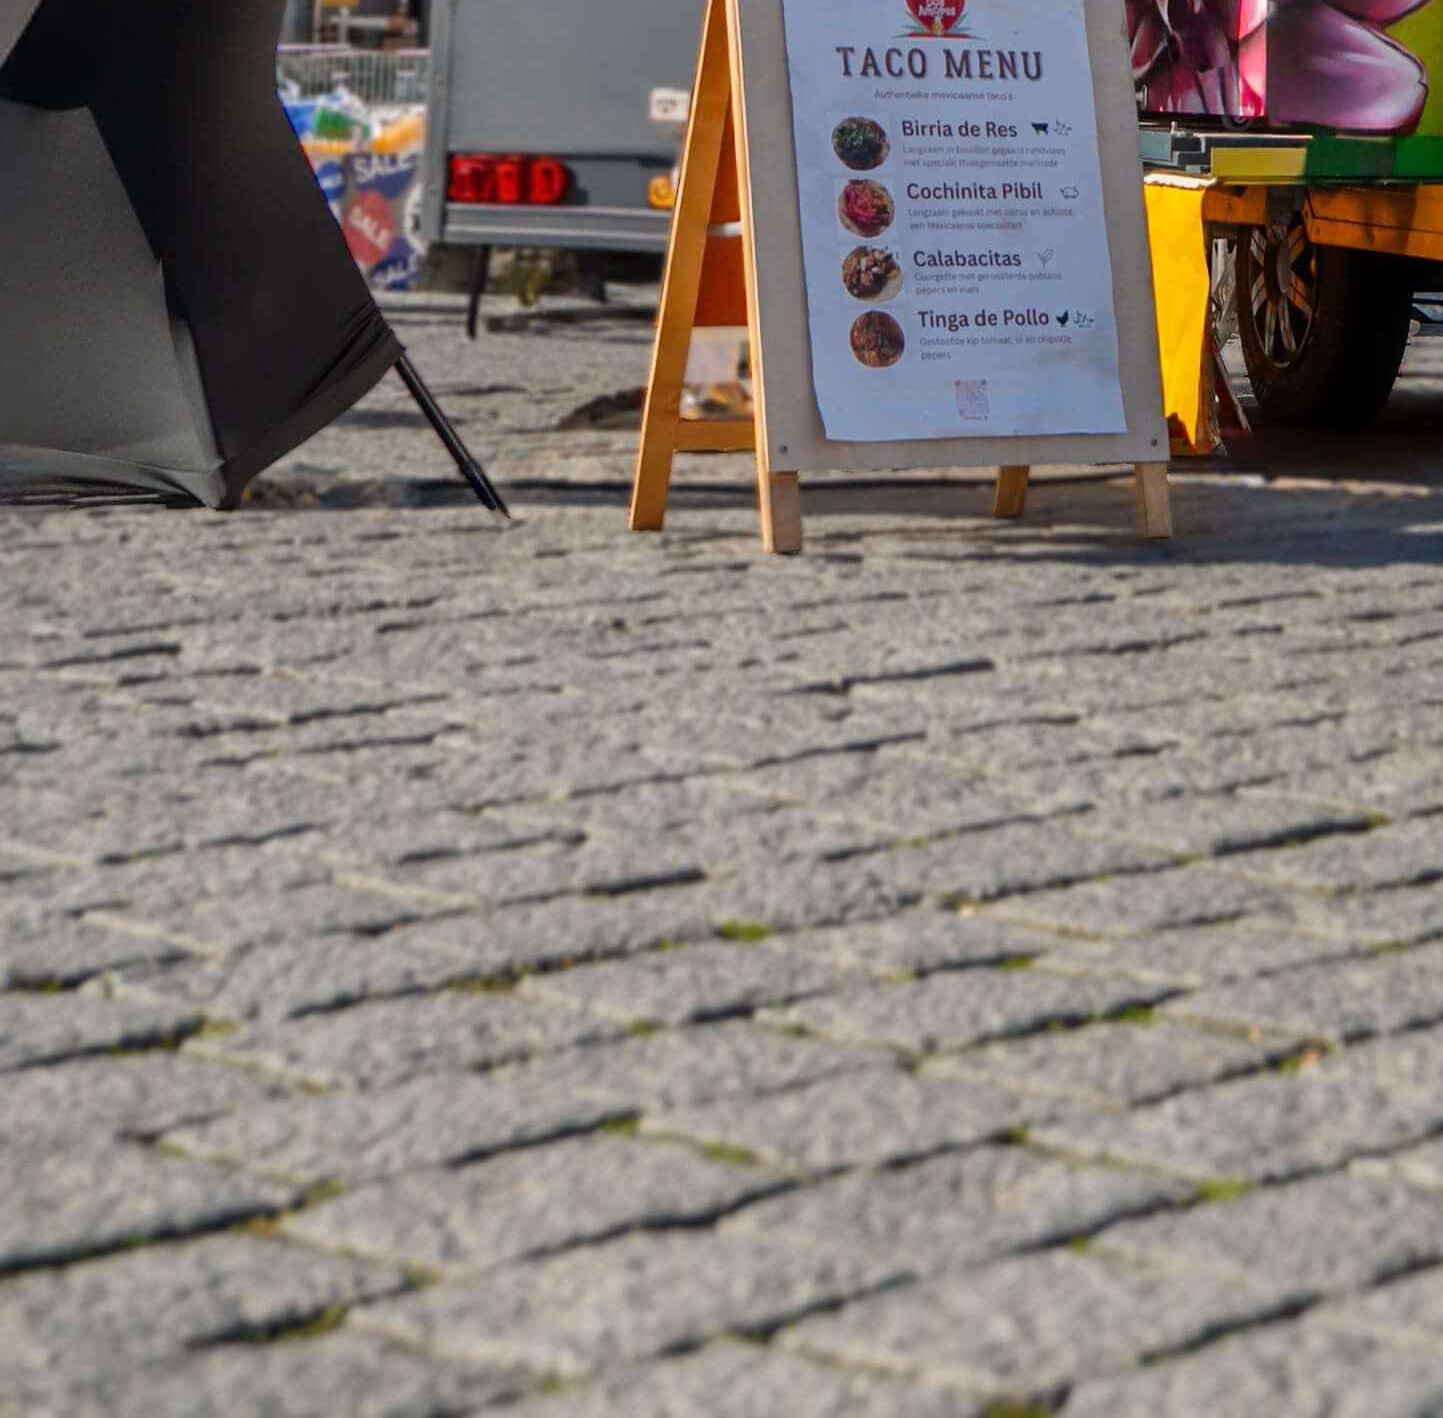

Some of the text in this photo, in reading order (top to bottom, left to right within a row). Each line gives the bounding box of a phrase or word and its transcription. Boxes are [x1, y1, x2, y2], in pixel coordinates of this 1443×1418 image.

[835, 46, 1042, 80] TACO MENU
[902, 120, 1017, 137] Birria de Res
[907, 182, 1043, 199] Cochinita Pibil
[913, 249, 1022, 267] Calabacitas
[917, 308, 1049, 332] Tinga de Pollo
